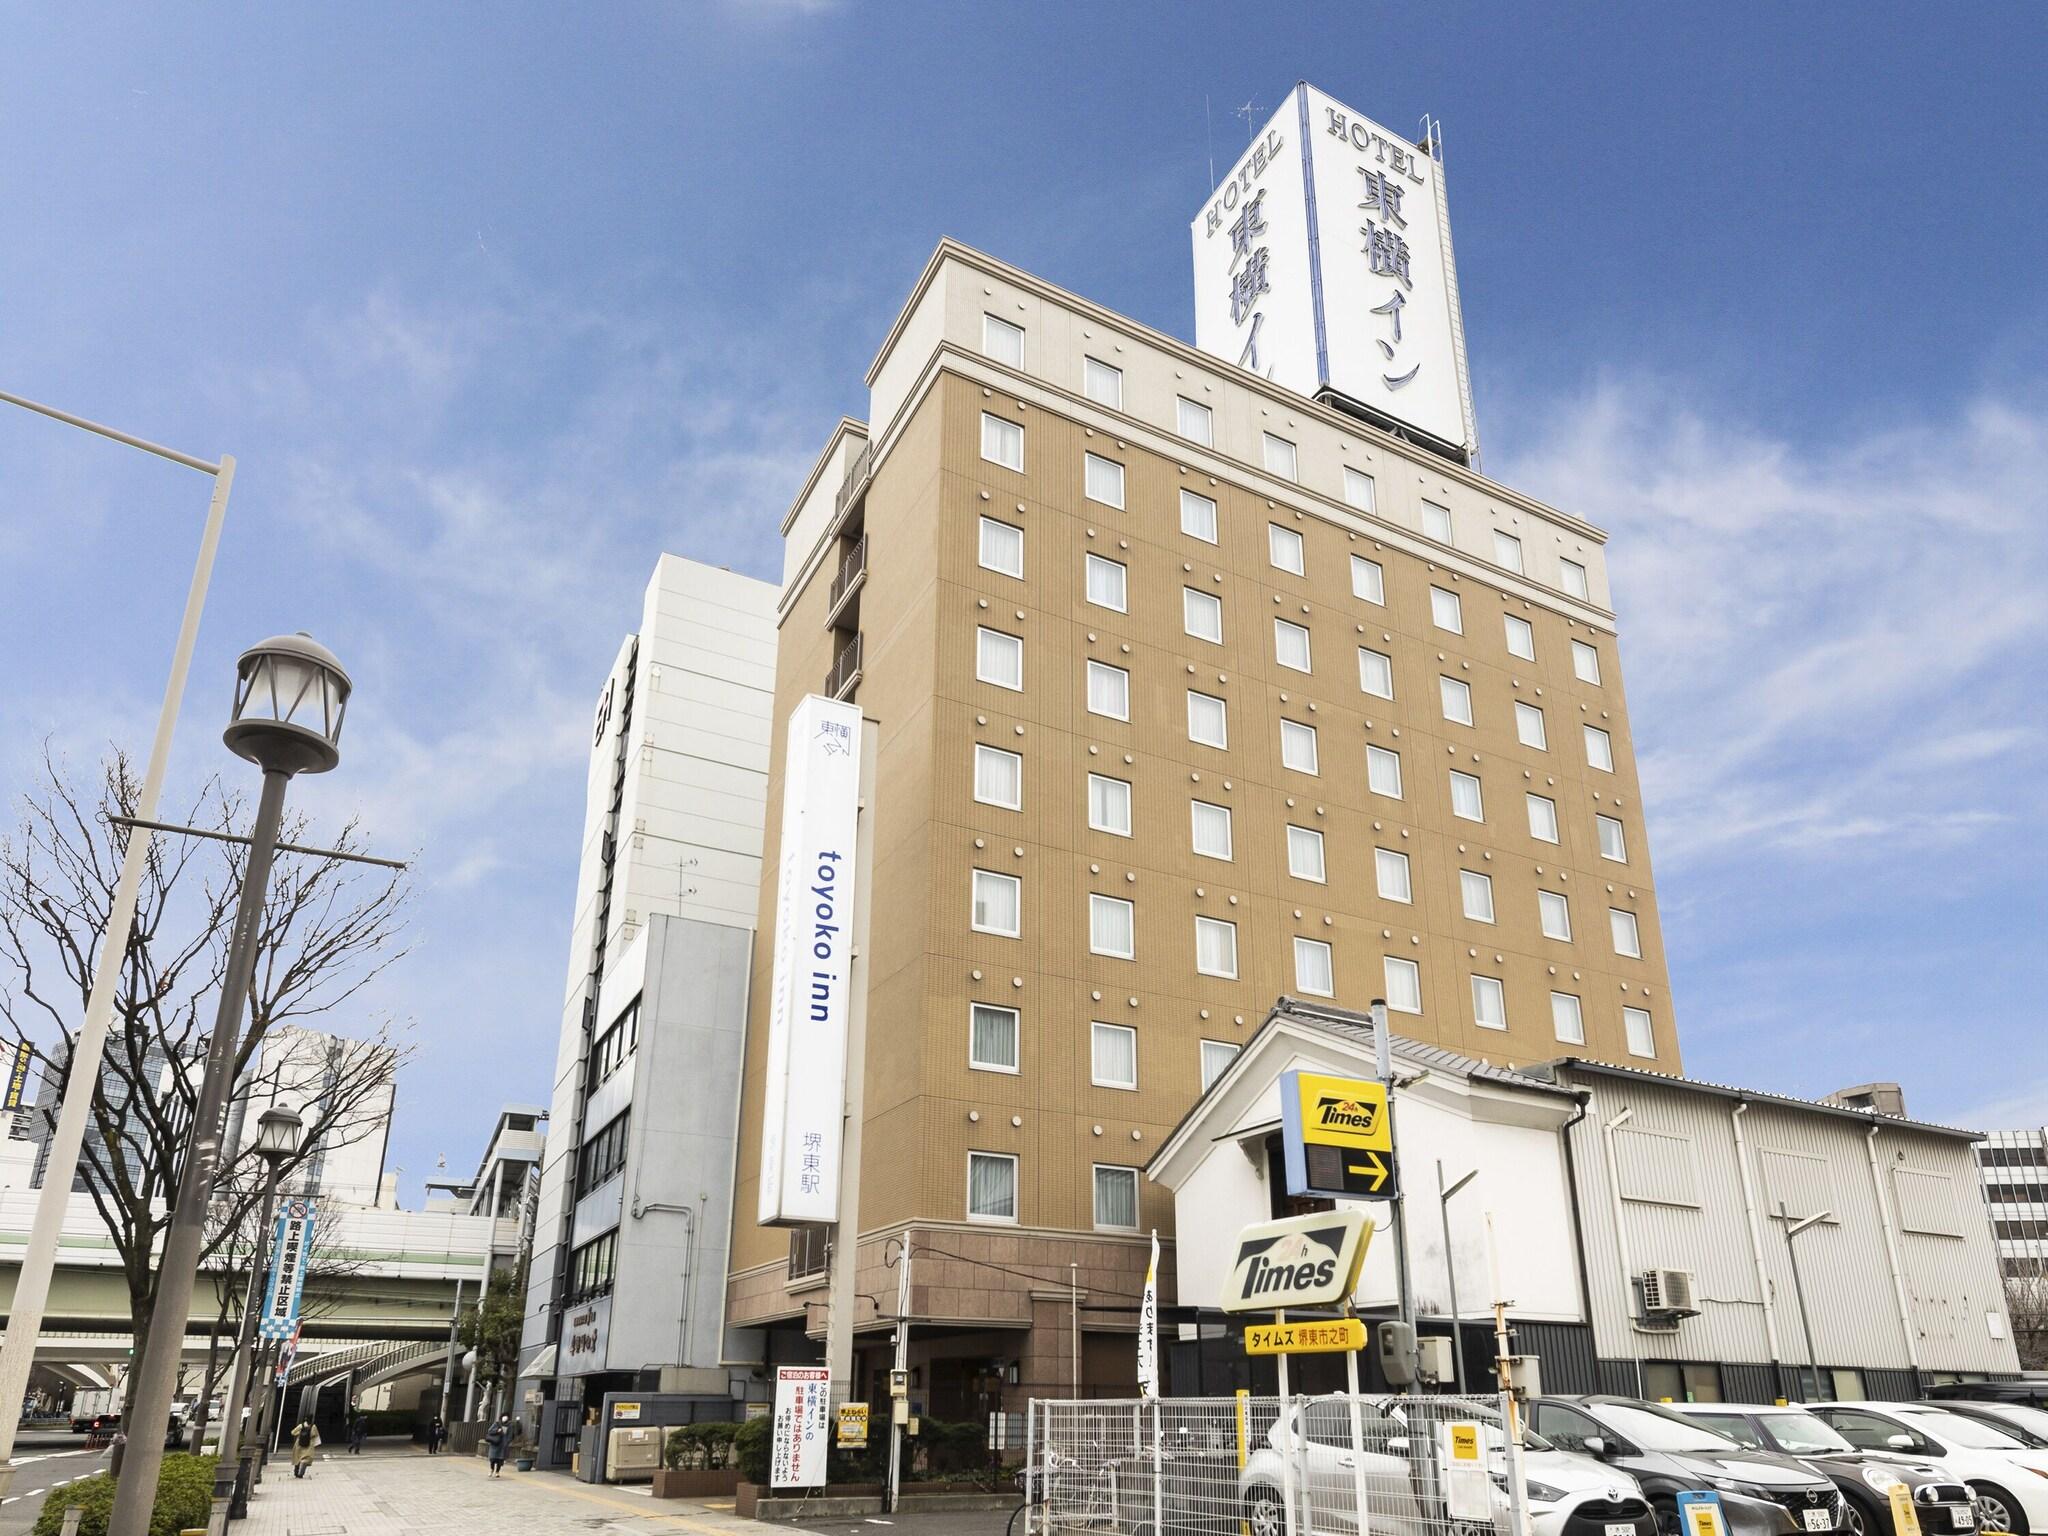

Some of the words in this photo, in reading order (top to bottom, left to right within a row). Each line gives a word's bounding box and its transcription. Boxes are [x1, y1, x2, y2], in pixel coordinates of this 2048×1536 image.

[1325, 106, 1426, 186] HOTEL
[1206, 129, 1284, 239] HOTEL
[1226, 187, 1273, 379] 東横イ
[1355, 165, 1422, 392] 東横イン
[811, 850, 842, 960] toyoko
[811, 971, 837, 1022] inn
[1320, 1106, 1373, 1129] Times
[800, 1131, 822, 1195] 堺東駅
[1241, 1256, 1337, 1300] Times
[1252, 1330, 1294, 1347] タイムズ
[1298, 1326, 1350, 1346] 堺東市之町
[791, 1386, 804, 1482] 駐車場ではありません
[805, 1382, 817, 1441] 東横インの
[1455, 1436, 1474, 1445] Times
